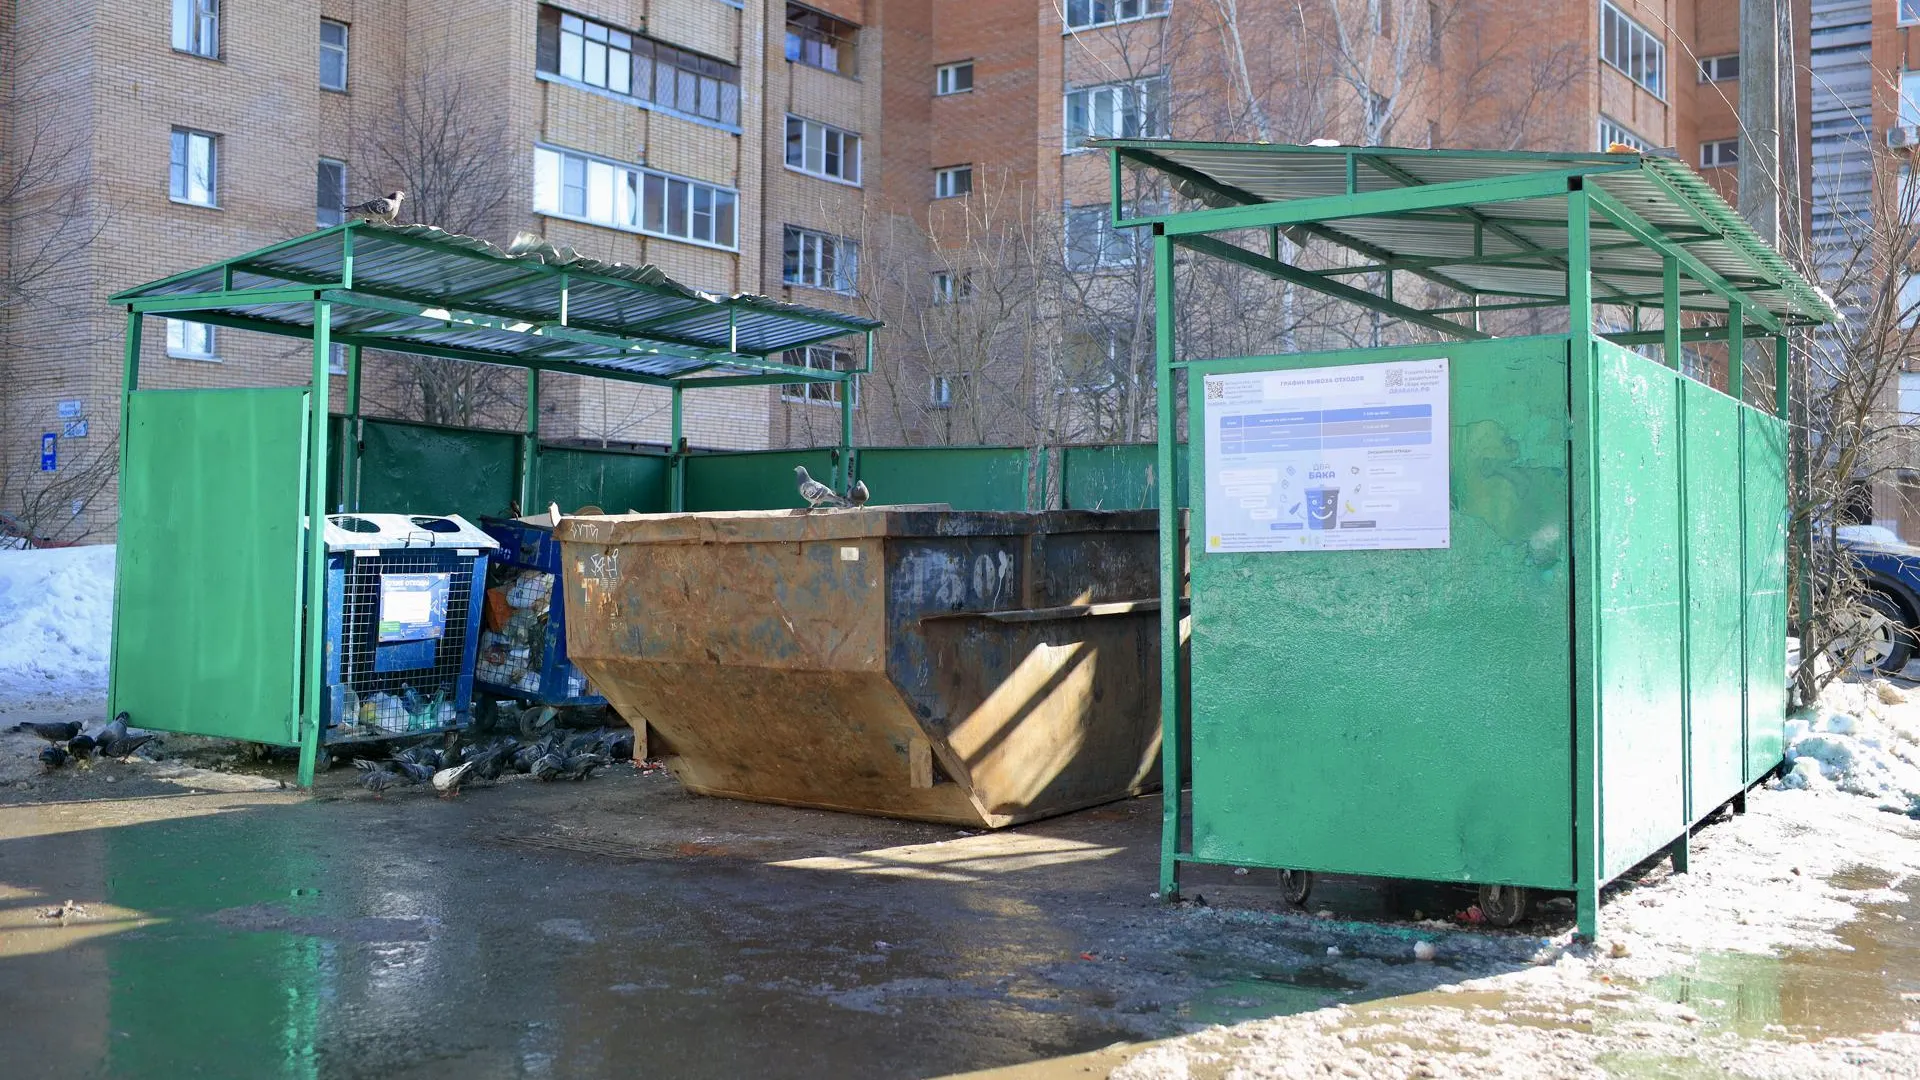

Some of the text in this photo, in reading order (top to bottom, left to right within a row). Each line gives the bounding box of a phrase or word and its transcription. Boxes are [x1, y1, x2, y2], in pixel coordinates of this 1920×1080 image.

[1334, 375, 1365, 383] ОТХОДОВ
[1313, 463, 1331, 471] ДВА
[1308, 470, 1336, 479] БАКА
